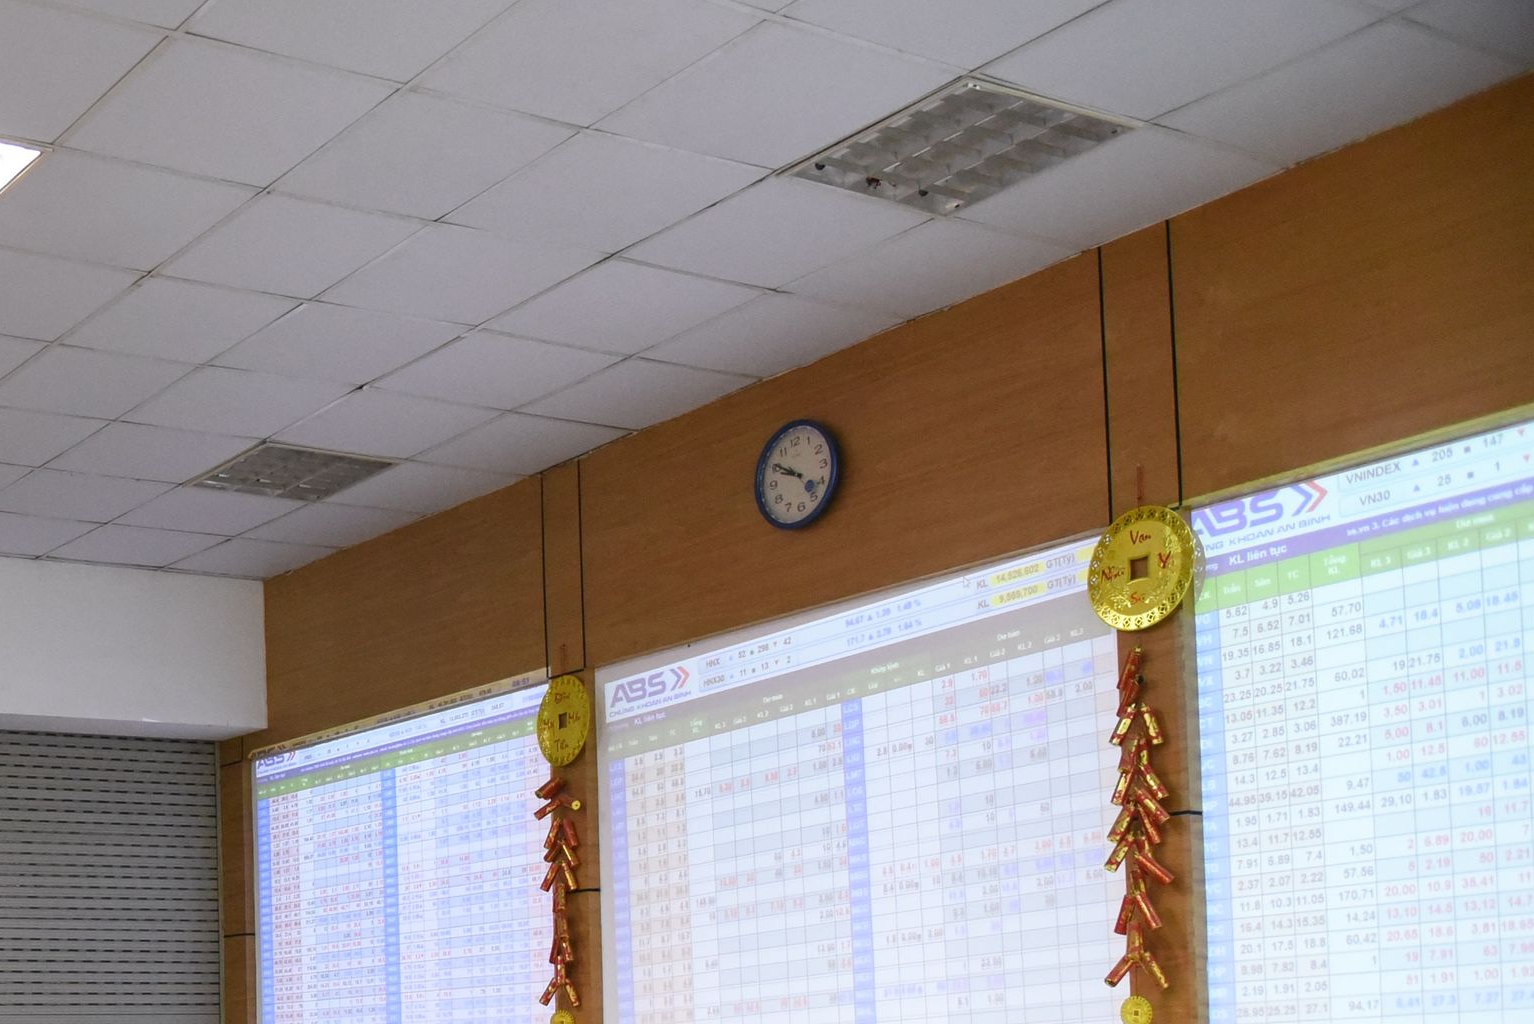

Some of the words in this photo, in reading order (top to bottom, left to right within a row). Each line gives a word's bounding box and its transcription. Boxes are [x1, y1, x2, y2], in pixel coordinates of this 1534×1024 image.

[1346, 462, 1402, 485] VNINDEX
[1431, 448, 1453, 462] 205
[1483, 434, 1504, 449] 147
[1359, 490, 1391, 506] VN30
[1229, 554, 1245, 566] KL
[978, 599, 990, 610] KL
[1263, 598, 1278, 610] 4.9
[1233, 626, 1249, 638] 7.5
[1289, 613, 1311, 626] 7.01
[1331, 602, 1361, 617] 57.70
[1222, 648, 1249, 661] 19.35
[1253, 642, 1281, 656] 16.85
[1291, 634, 1312, 647] 18.1
[1224, 689, 1251, 703] 23.25
[1254, 684, 1283, 697] 20.25
[1286, 678, 1315, 691] 21.75
[1408, 653, 1441, 668] 21.75
[1235, 668, 1250, 680] 3.7
[1259, 662, 1282, 675] 3.22
[610, 668, 666, 708] ABS
[1226, 711, 1253, 724] 13.05
[1257, 705, 1284, 718] 11.35
[1293, 699, 1316, 711] 12.2
[1232, 732, 1253, 744] 3.27
[1338, 734, 1368, 748] 22.21
